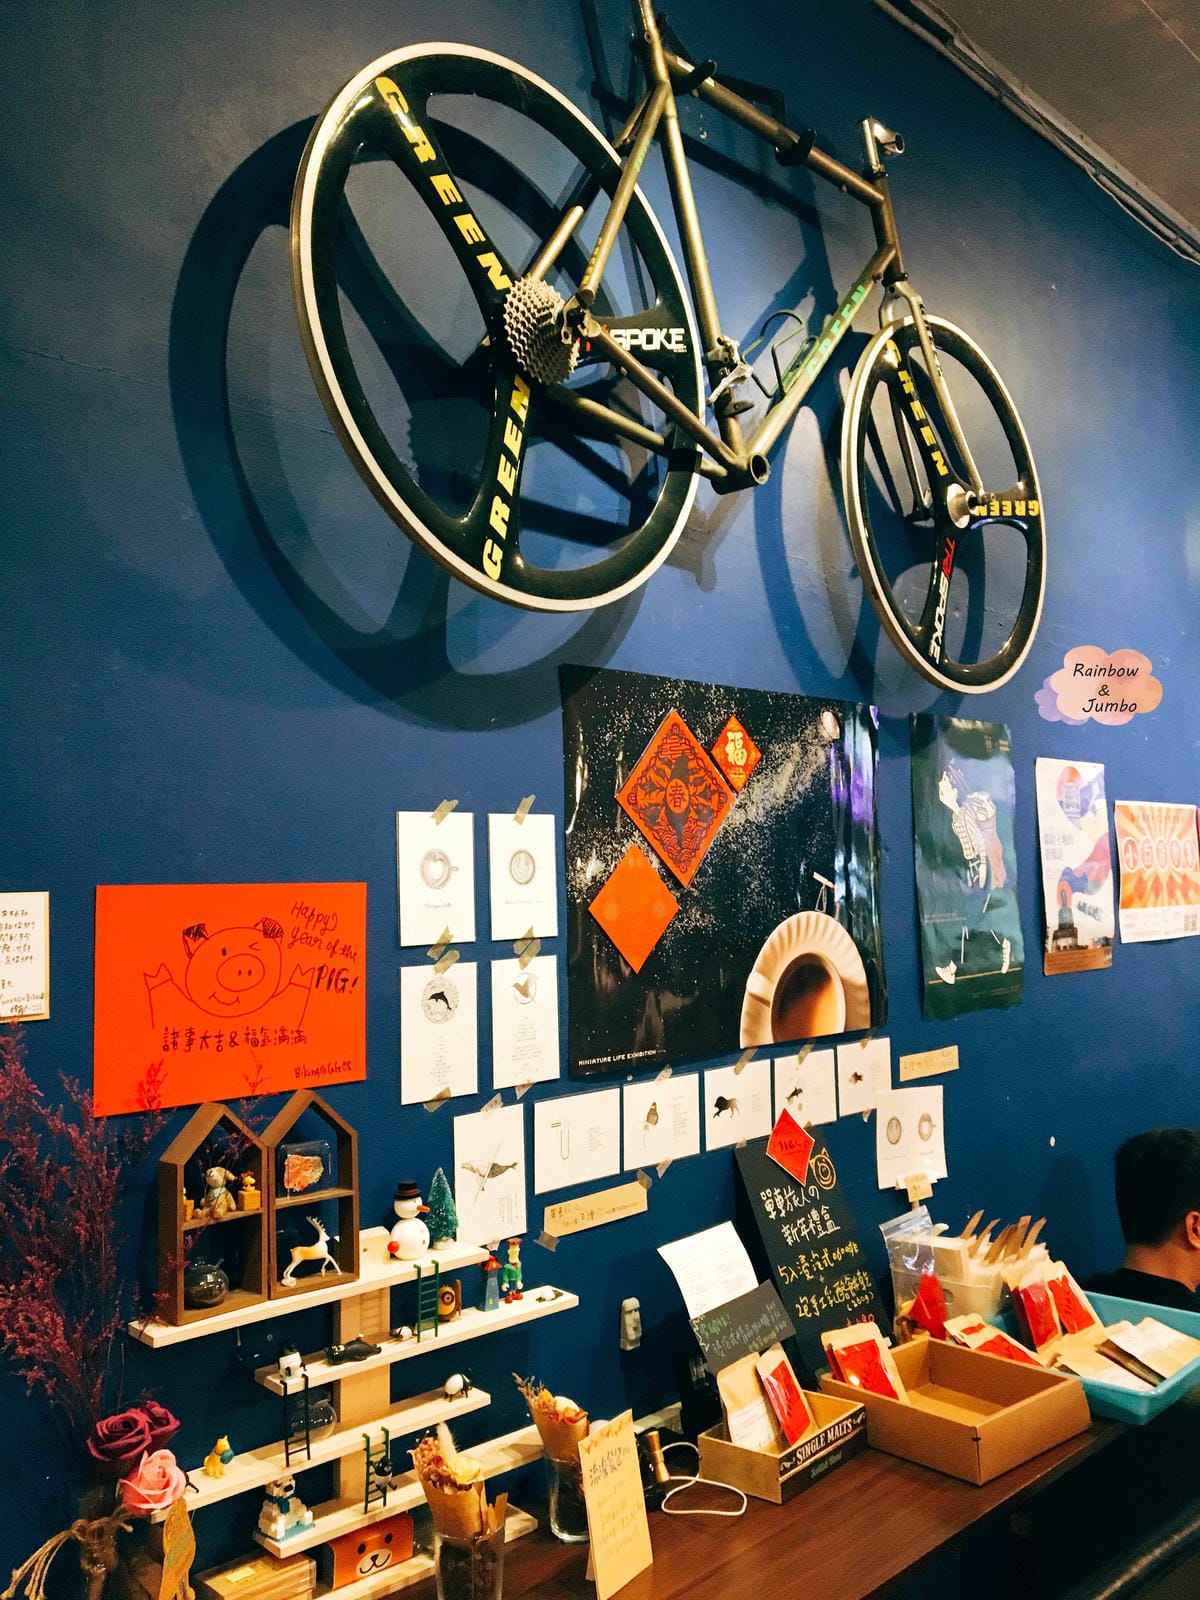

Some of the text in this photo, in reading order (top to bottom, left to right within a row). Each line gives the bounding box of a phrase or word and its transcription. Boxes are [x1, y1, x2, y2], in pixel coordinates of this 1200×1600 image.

[374, 76, 513, 291] GREEN
[482, 374, 531, 581] GREEN
[725, 731, 748, 766] 福
[669, 781, 687, 808] 春
[290, 900, 339, 937] Happy
[326, 938, 340, 959] of
[340, 943, 358, 964] the
[315, 962, 360, 994] PIG!
[578, 1049, 657, 1067] MINIATURE LIFE EXHIBITION
[781, 1205, 841, 1246] 新年禮盒
[796, 1433, 826, 1465] SINGLE
[827, 1418, 853, 1443] MALTS
